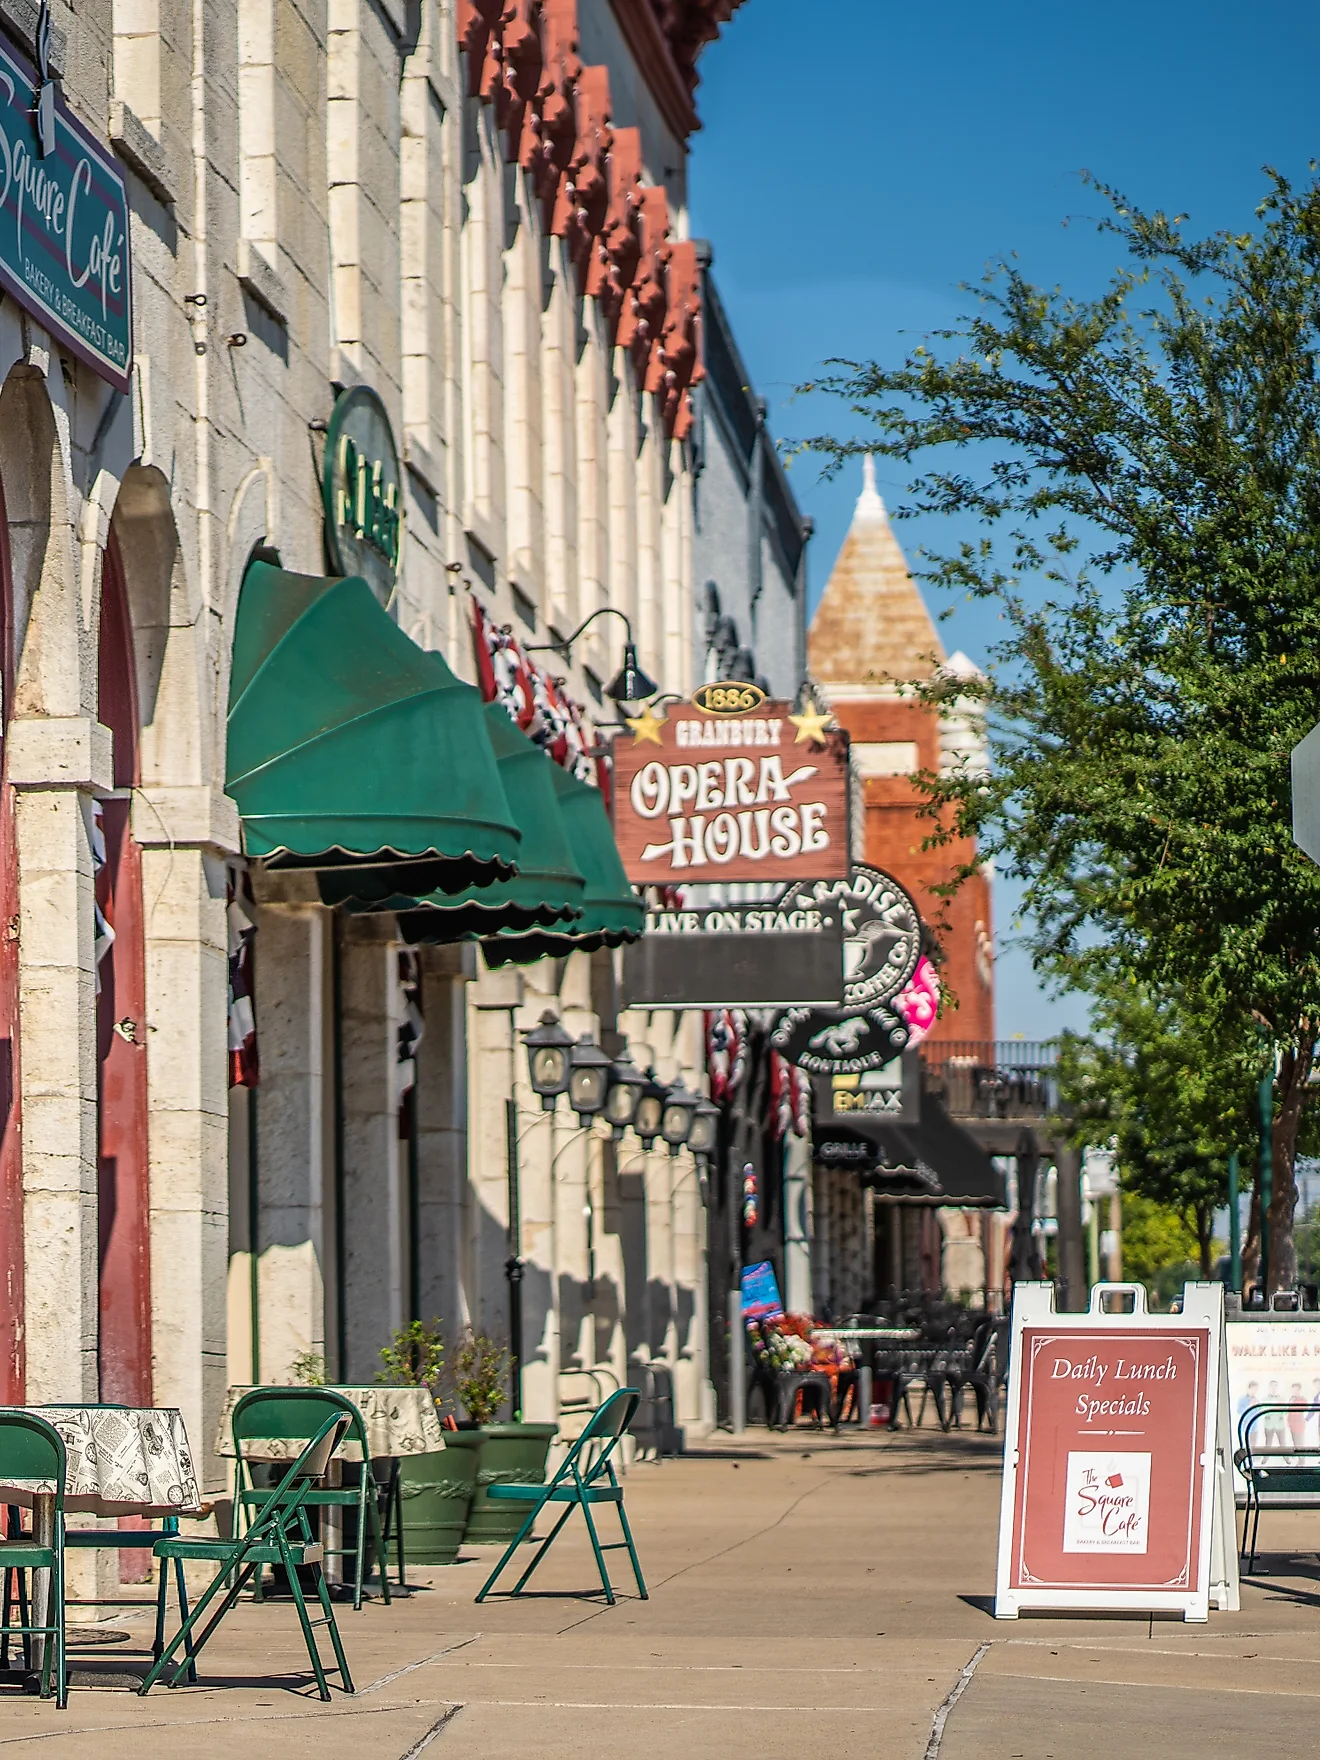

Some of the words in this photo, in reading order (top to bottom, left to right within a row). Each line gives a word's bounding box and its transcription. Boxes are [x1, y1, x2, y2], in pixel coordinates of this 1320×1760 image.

[66, 158, 123, 321] Café
[25, 257, 54, 304] BAKERY
[62, 294, 107, 349] BREAKFAST
[108, 334, 125, 363] BAR
[703, 688, 755, 708] 1886
[675, 719, 782, 747] GRANBURY
[631, 755, 819, 818] OPERA
[640, 802, 830, 868] HOUSE
[645, 911, 700, 932] LIVE
[705, 911, 740, 932] ON
[745, 911, 822, 933] STAGE
[798, 1051, 883, 1074] BOUTIQUE
[1232, 1344, 1267, 1356] WALK
[1271, 1344, 1297, 1356] LIKE
[1302, 1345, 1309, 1356] A
[1051, 1355, 1108, 1387] Daily
[1114, 1355, 1177, 1379] Lunch
[1075, 1391, 1151, 1423] Specials
[1082, 1468, 1098, 1484] The
[1078, 1485, 1133, 1519] Square
[1103, 1507, 1142, 1538] Café
